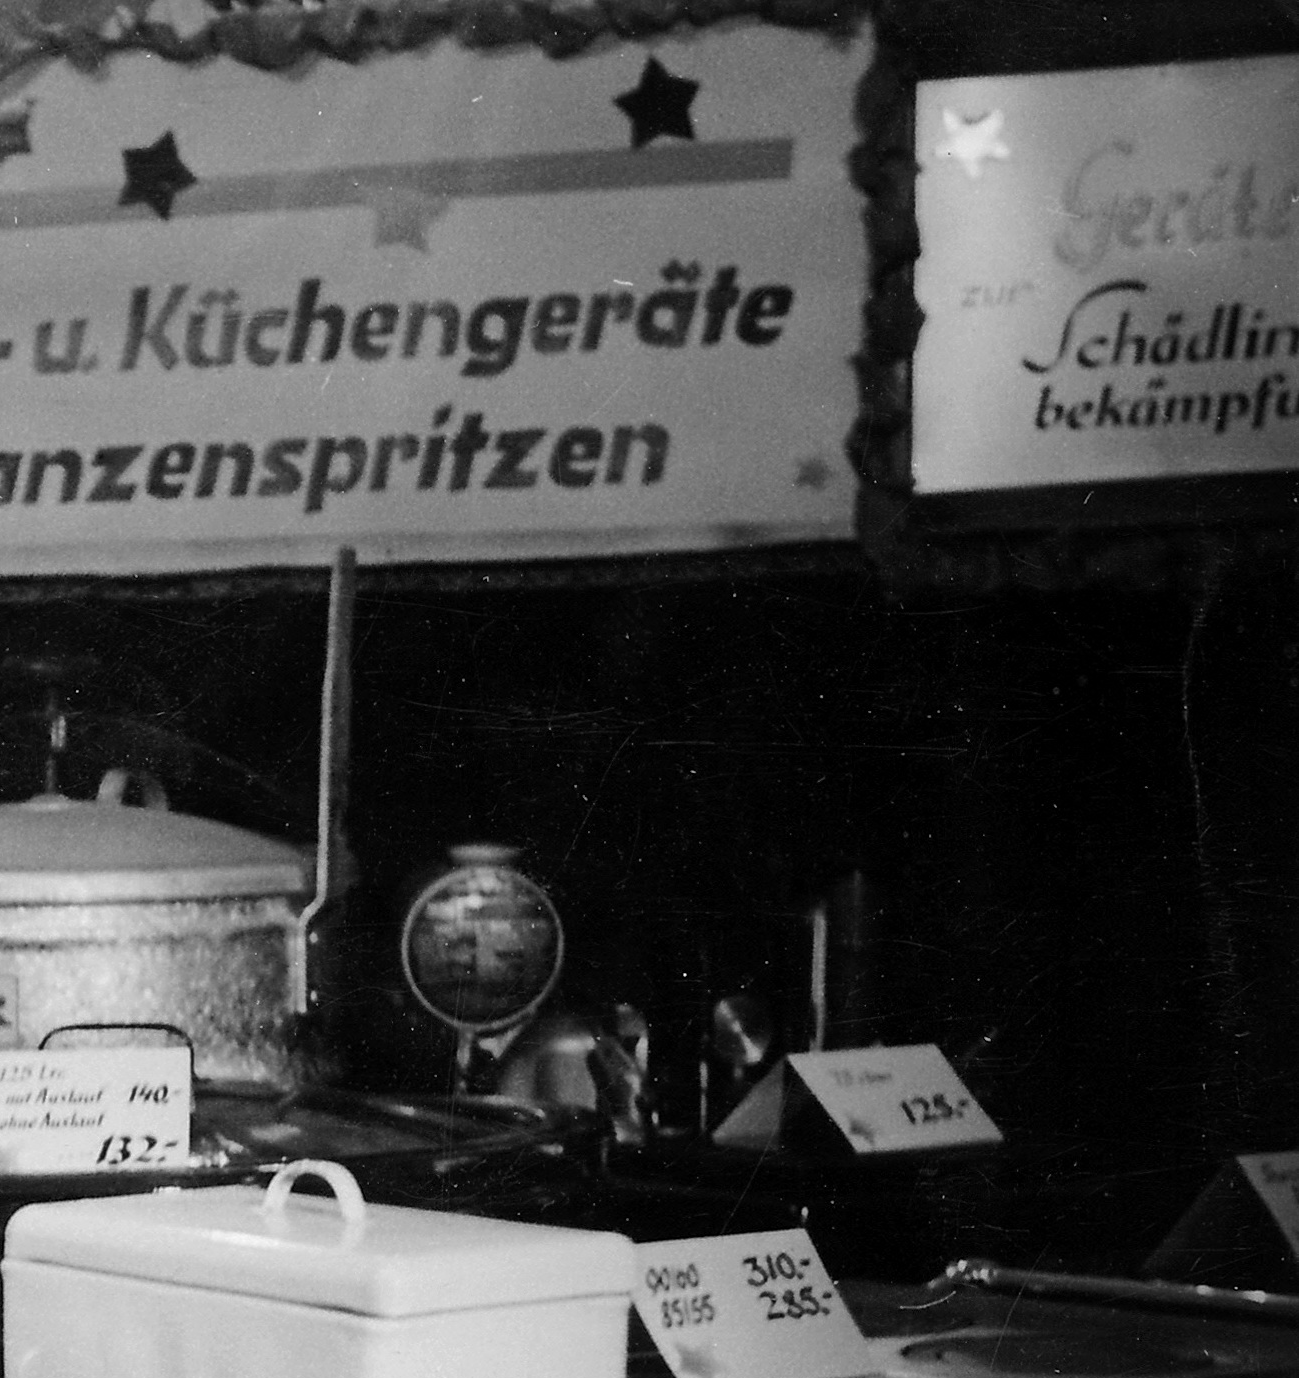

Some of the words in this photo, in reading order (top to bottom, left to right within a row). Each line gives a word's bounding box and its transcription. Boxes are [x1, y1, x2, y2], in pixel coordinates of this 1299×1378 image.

[34, 297, 99, 375] u.
[117, 259, 794, 377] Küchengeräte
[94, 1134, 180, 1166] 132.-
[741, 1250, 812, 1289] 310.-
[758, 1285, 834, 1321] 285.-
